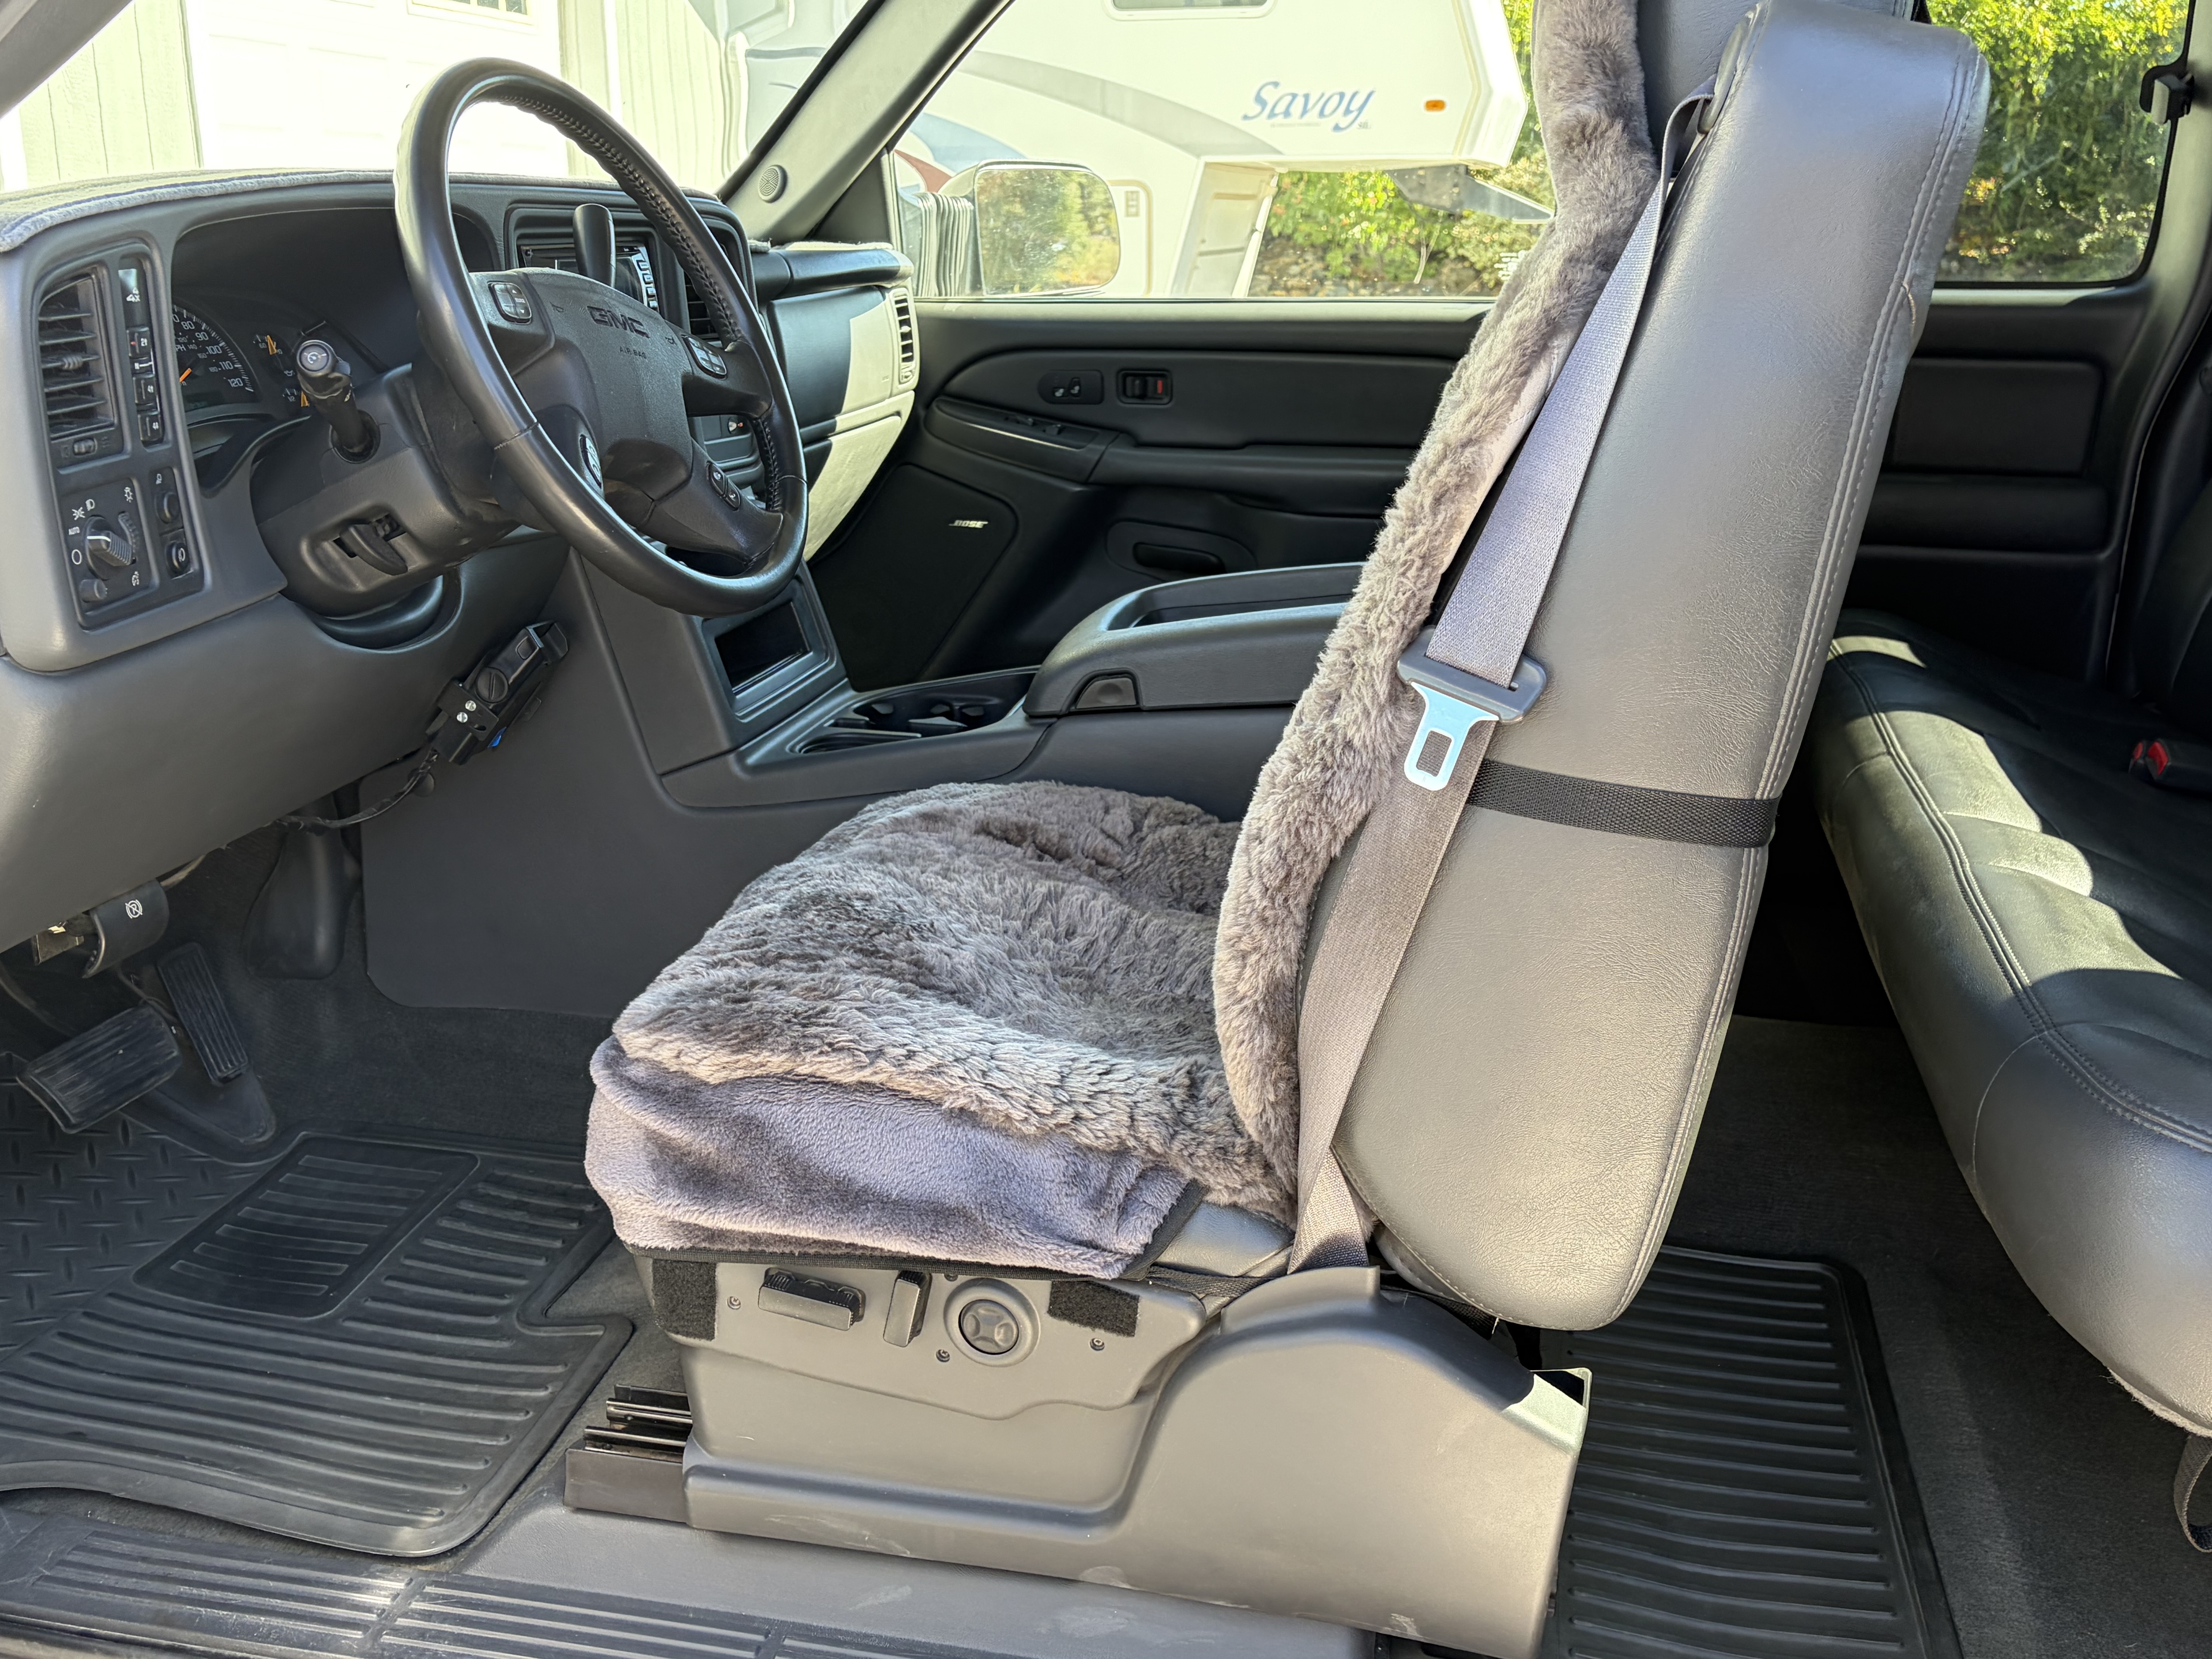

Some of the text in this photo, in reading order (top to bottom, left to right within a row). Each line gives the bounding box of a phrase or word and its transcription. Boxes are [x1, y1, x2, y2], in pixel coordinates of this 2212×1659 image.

[1241, 81, 1376, 132] Savoy
[181, 321, 195, 330] 80
[586, 306, 650, 339] GMC
[195, 332, 209, 341] 90
[206, 345, 222, 354] 100
[219, 361, 234, 370] 110
[228, 378, 243, 387] 120
[949, 519, 989, 529] BOSE
[68, 526, 80, 536] AUTO
